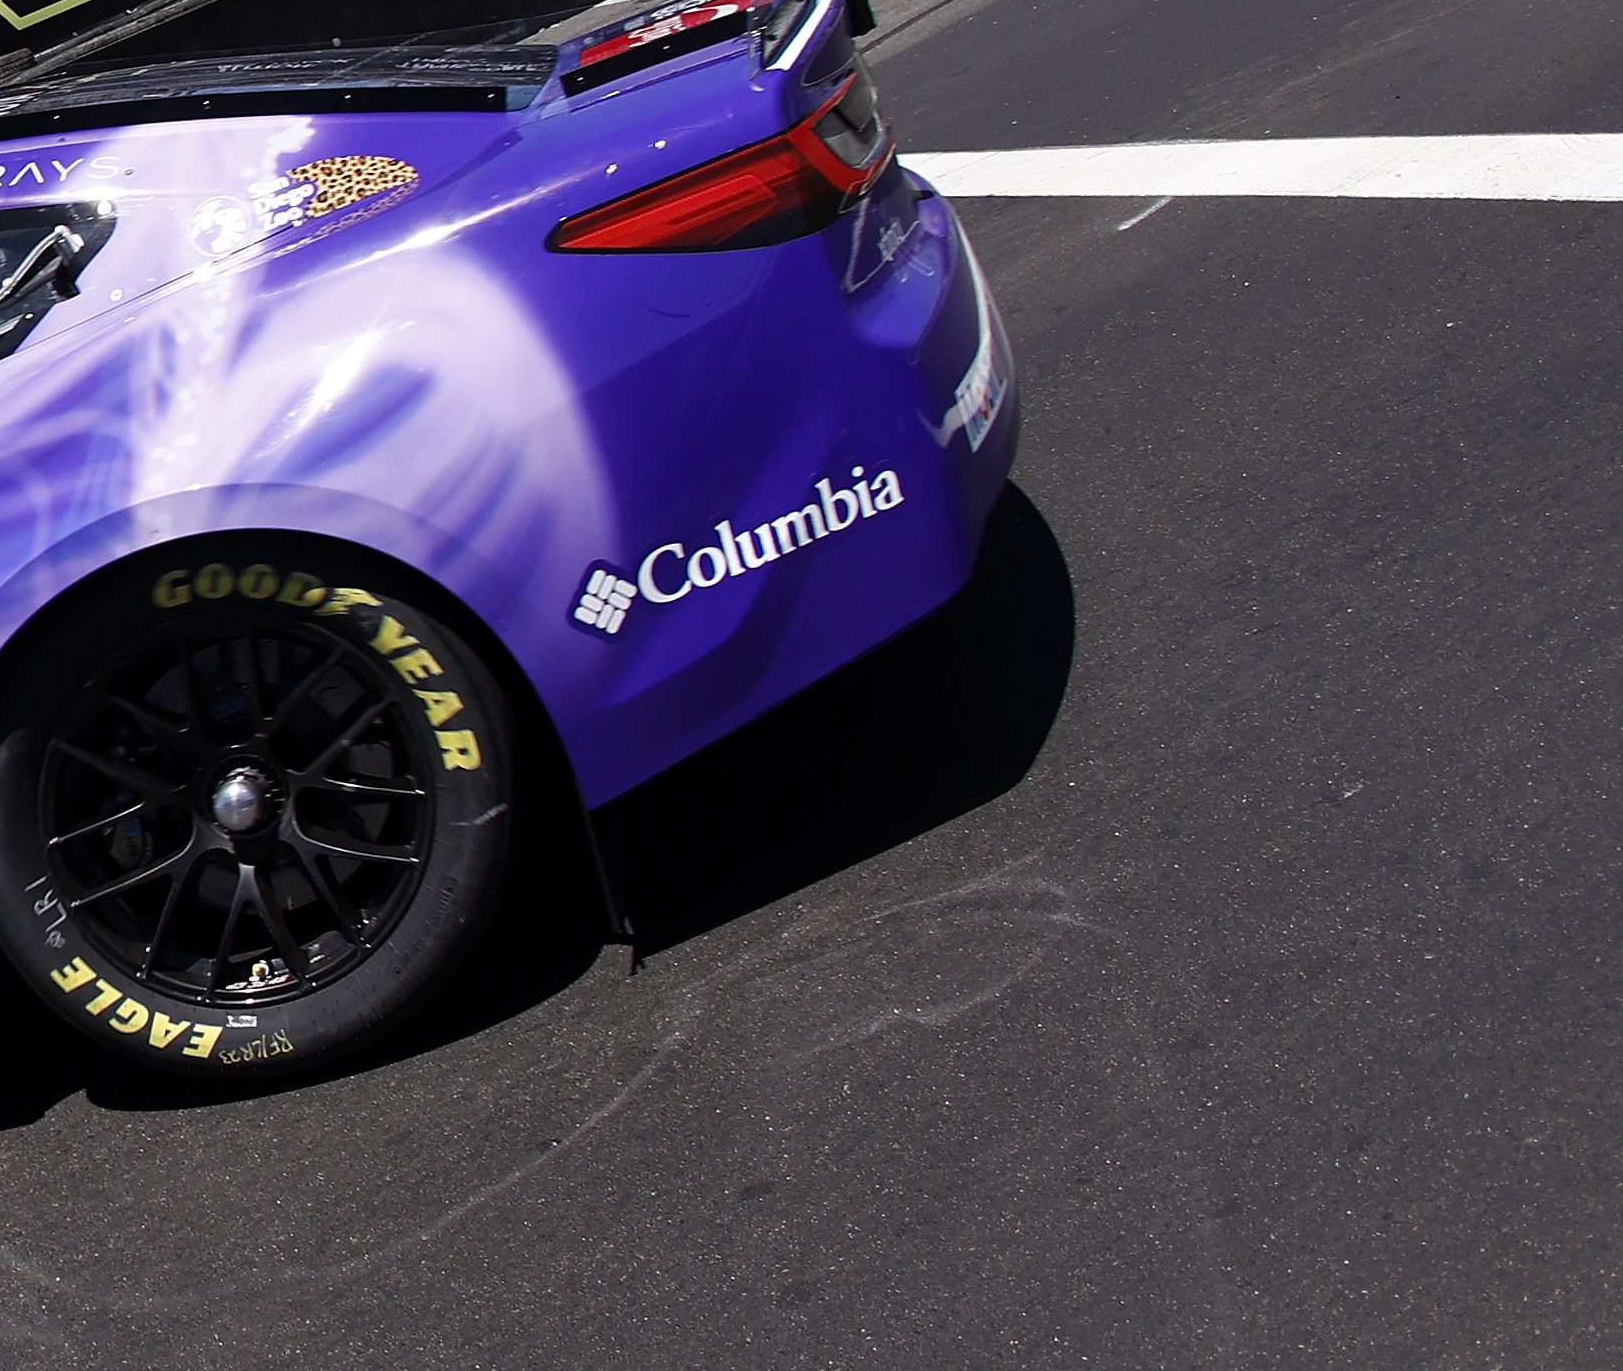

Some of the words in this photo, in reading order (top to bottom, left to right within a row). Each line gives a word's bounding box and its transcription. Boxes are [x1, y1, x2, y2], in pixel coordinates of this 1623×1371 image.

[254, 183, 315, 216] Diego
[638, 464, 906, 606] Columbia
[50, 955, 223, 1059] EAGLE
